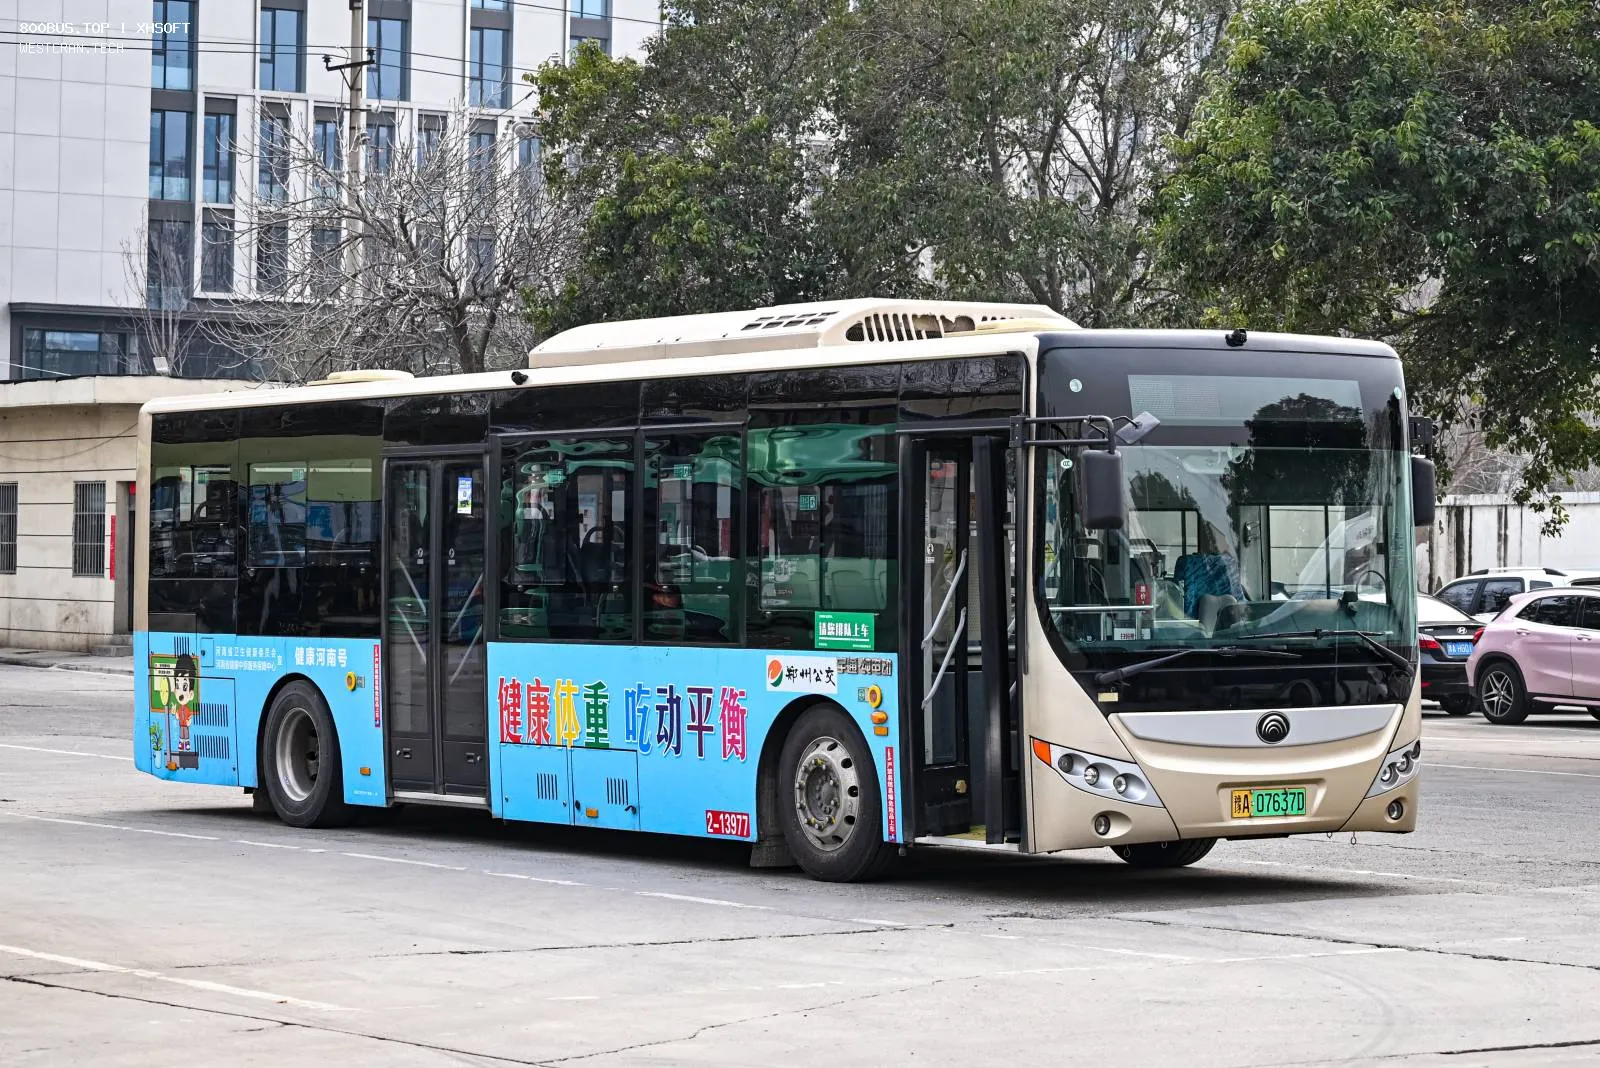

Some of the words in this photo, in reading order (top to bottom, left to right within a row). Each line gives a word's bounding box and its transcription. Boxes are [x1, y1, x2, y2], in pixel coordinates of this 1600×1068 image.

[294, 646, 348, 668] 健康河南号
[785, 665, 836, 687] 郑州公交
[498, 676, 610, 748] 健康体重
[624, 681, 748, 762] 吃动平衡
[706, 811, 749, 836] 2-13977
